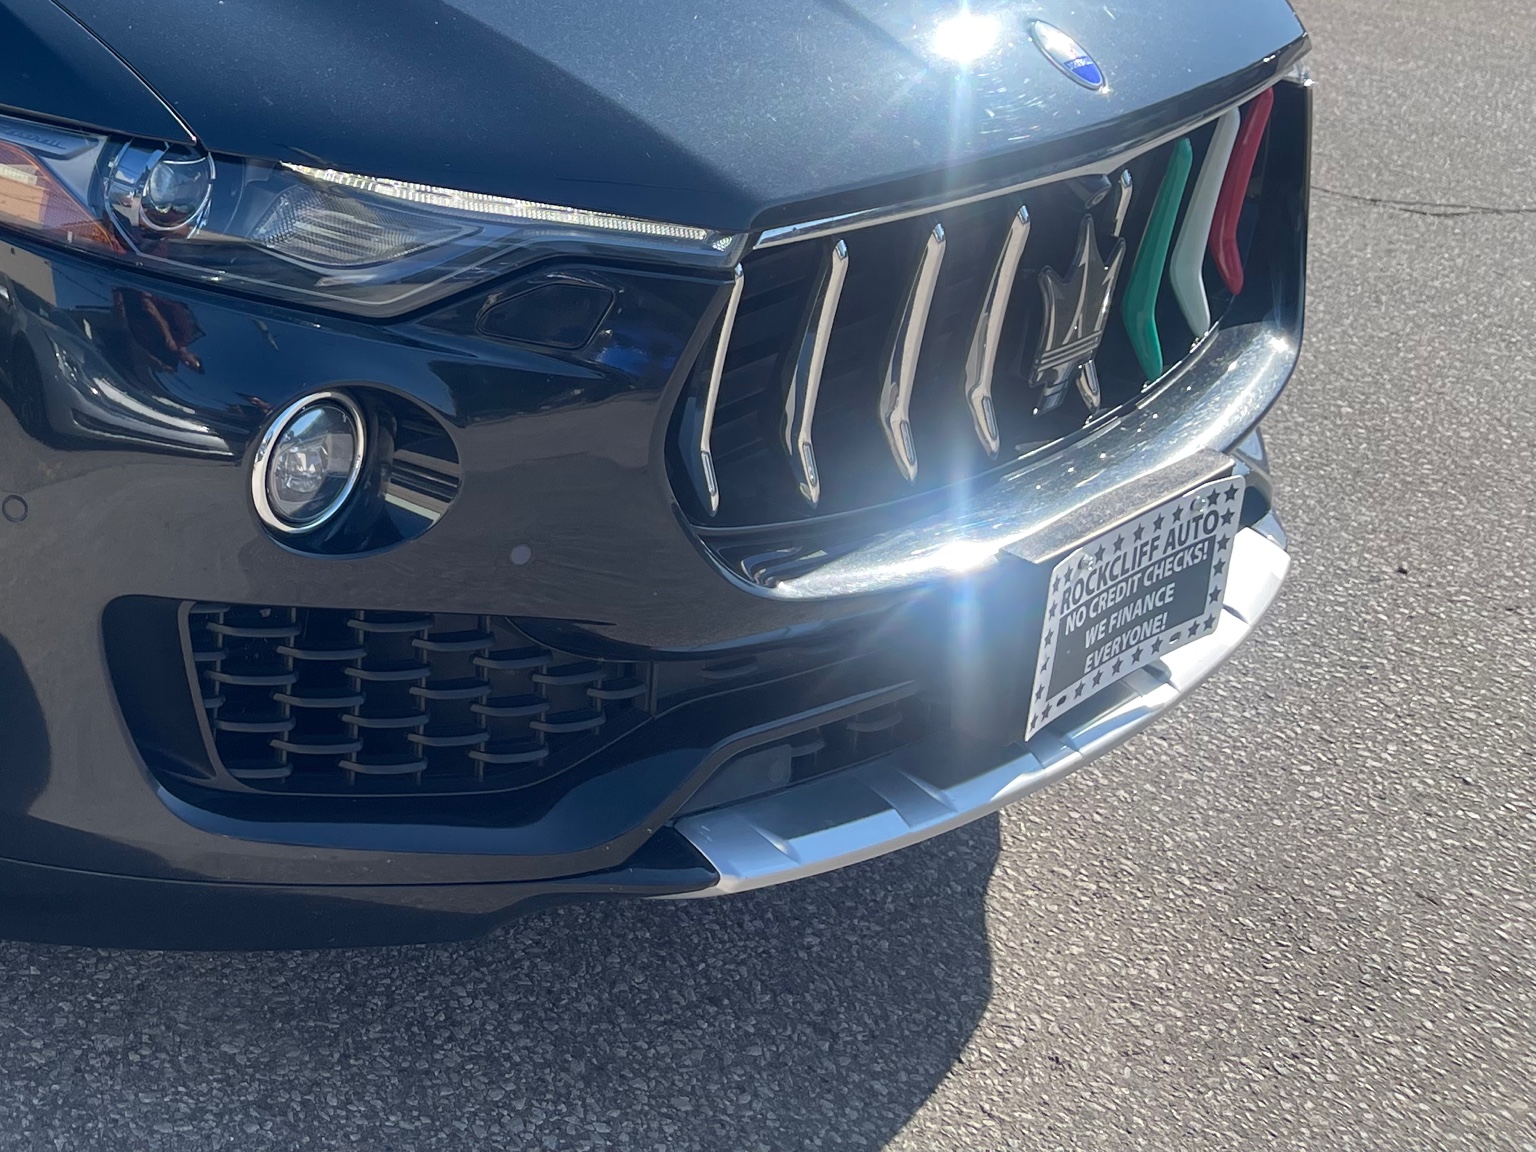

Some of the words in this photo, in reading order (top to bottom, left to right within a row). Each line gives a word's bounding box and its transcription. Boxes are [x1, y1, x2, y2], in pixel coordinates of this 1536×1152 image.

[1062, 535, 1161, 609] ROCKCLIFF
[1164, 510, 1220, 554] AUTO
[1065, 608, 1087, 635] NO
[1089, 573, 1142, 617] CREDIT
[1144, 541, 1209, 586] CHECKS!
[1083, 612, 1168, 674] EVERYONE!
[1084, 620, 1107, 648] WE
[1108, 583, 1176, 633] FINANCE
